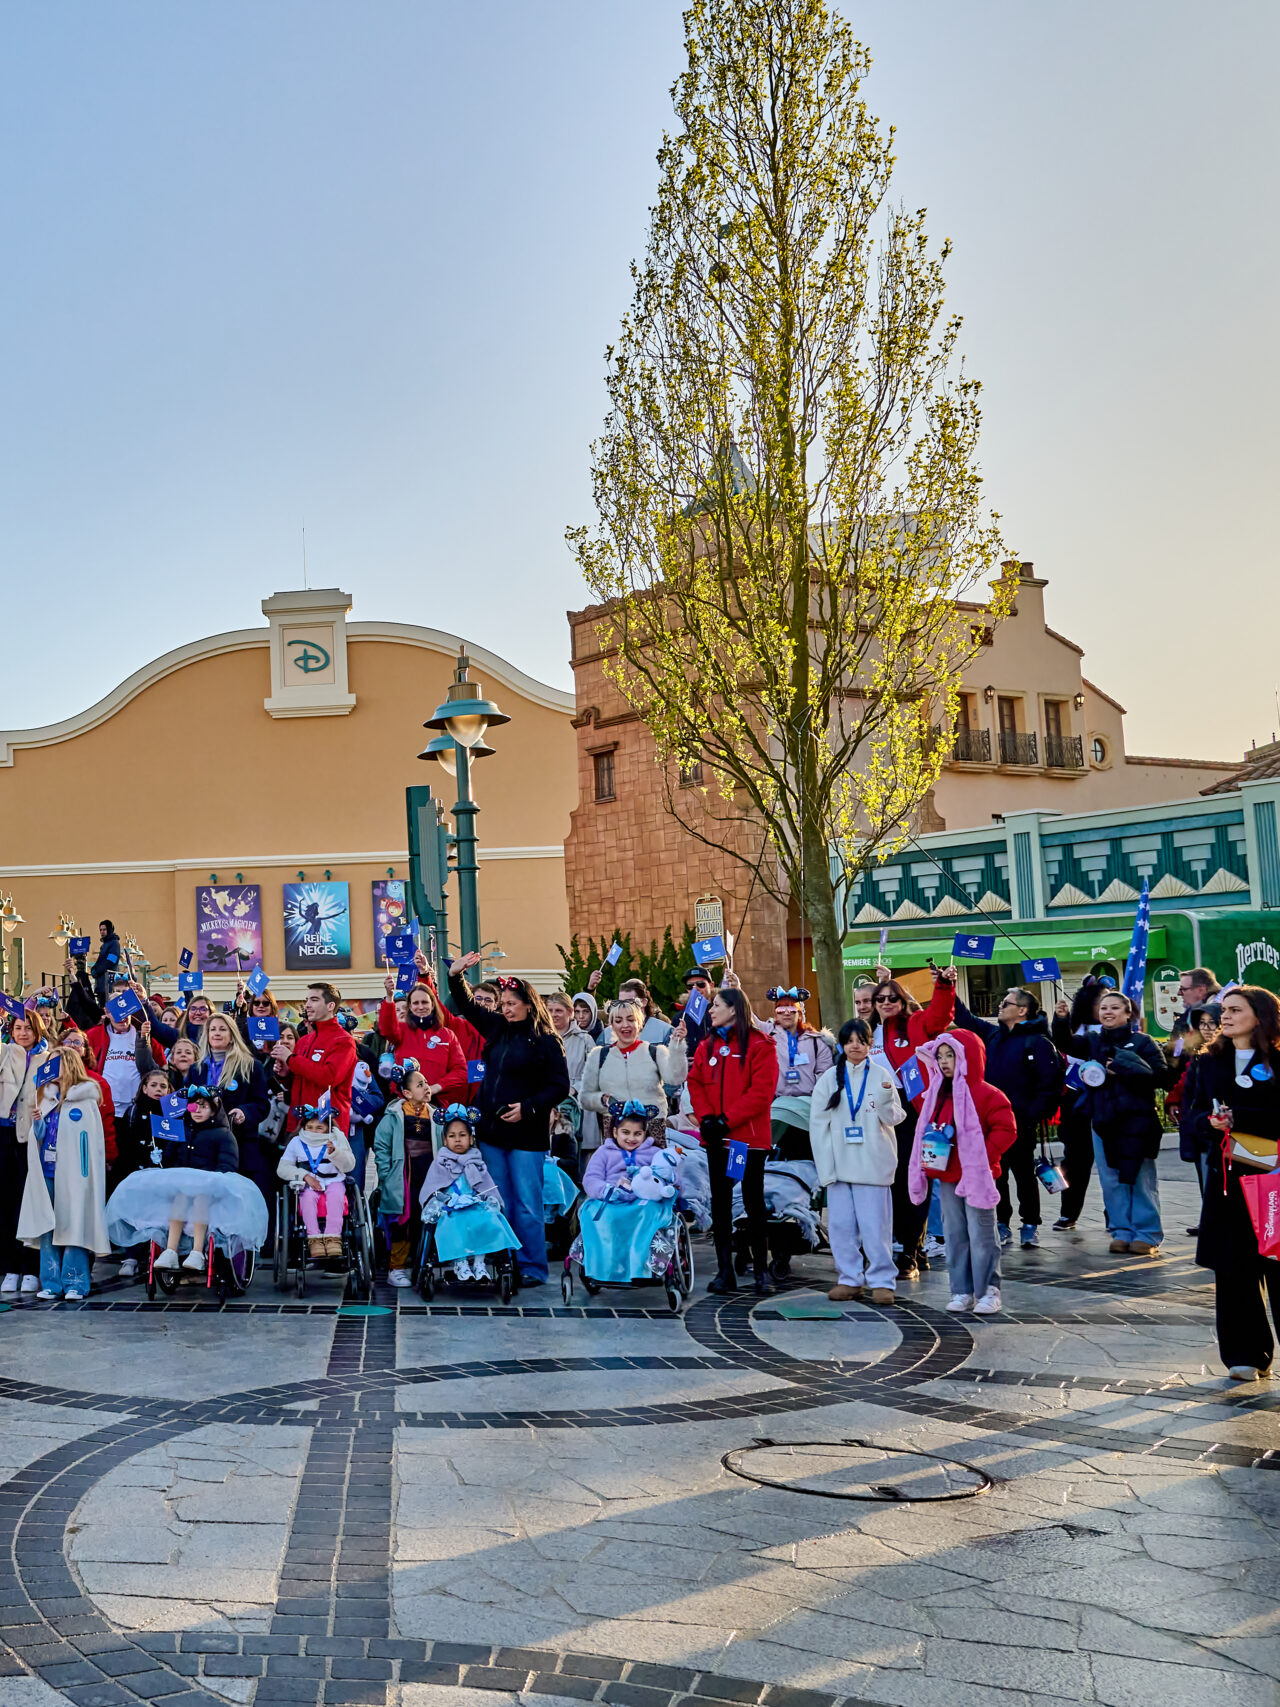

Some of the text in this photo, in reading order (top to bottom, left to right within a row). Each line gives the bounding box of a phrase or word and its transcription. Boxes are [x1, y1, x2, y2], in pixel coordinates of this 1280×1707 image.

[200, 920, 221, 933] MICKEY
[229, 918, 257, 931] MAGICIEN
[303, 932, 333, 943] REINE
[299, 943, 338, 957] NEIGES
